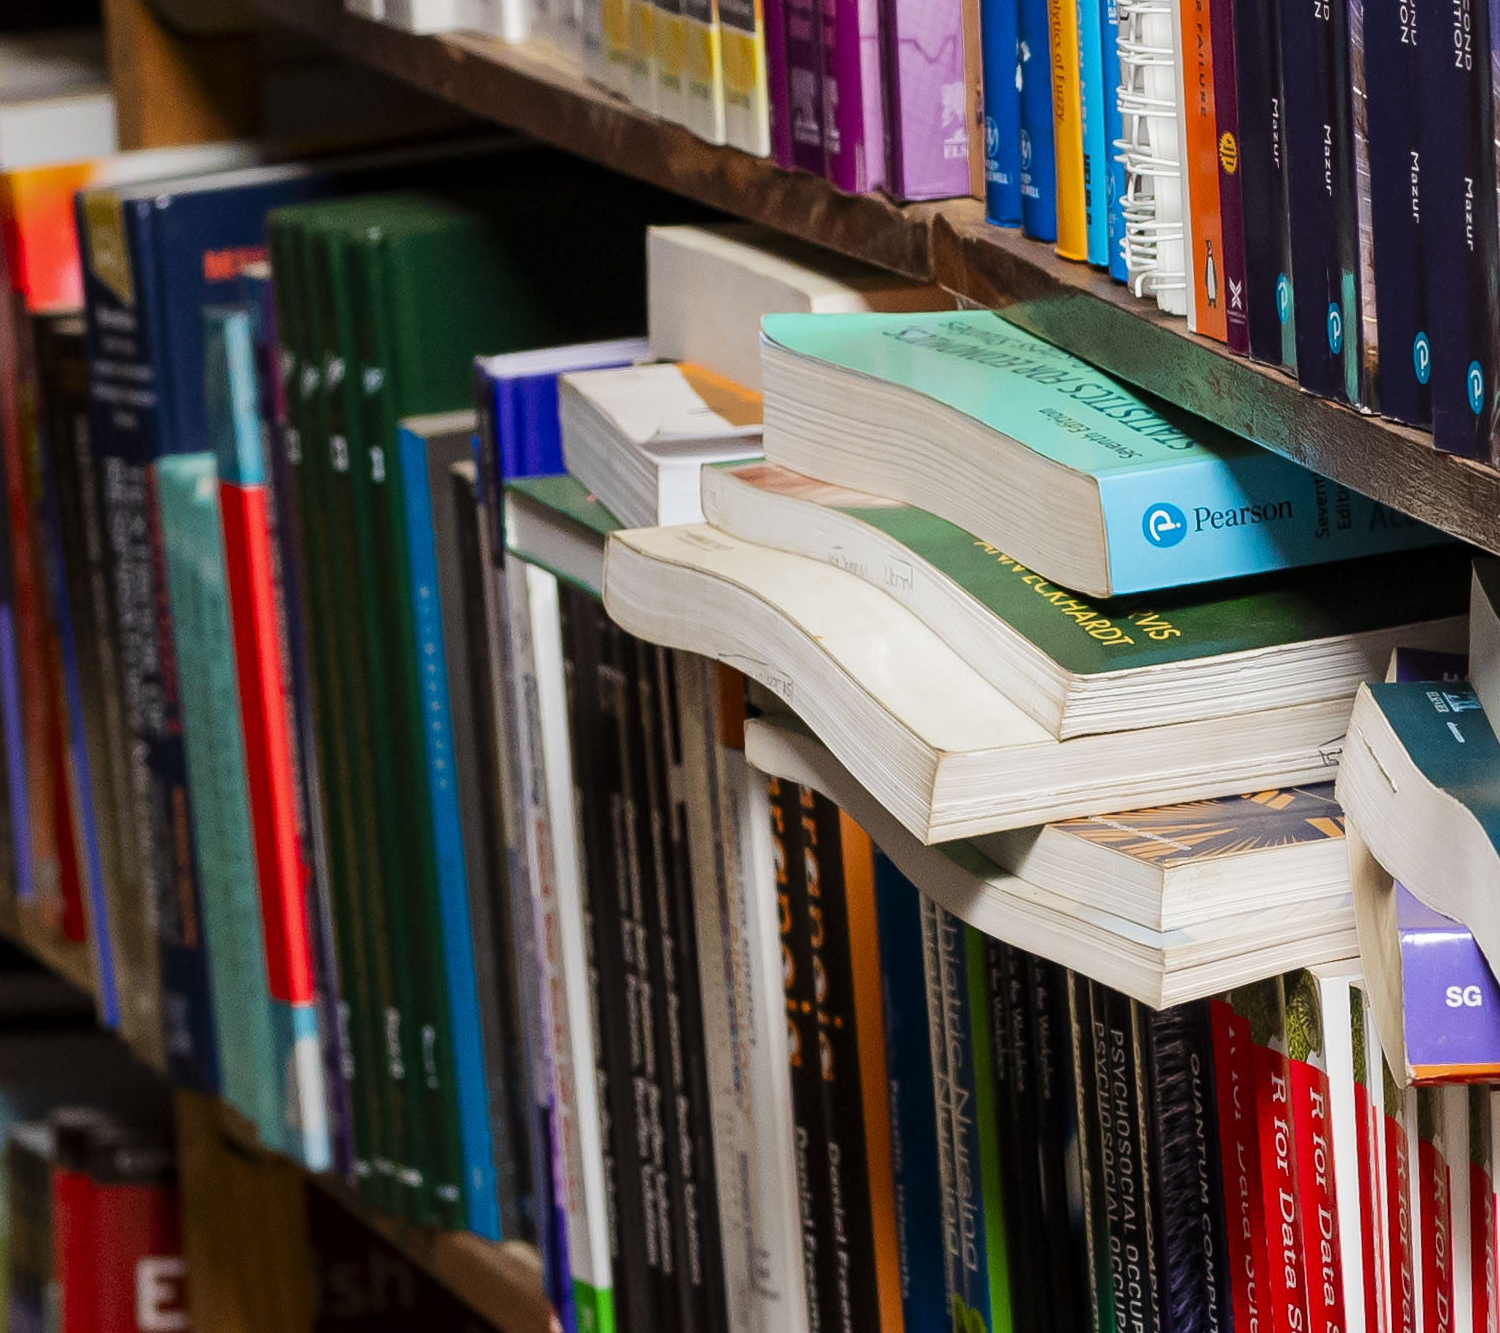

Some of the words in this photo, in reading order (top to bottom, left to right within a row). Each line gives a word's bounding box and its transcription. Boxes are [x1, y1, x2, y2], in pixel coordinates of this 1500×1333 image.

[1271, 98, 1280, 169] Mazur
[1323, 124, 1334, 196] Mazur
[1410, 151, 1421, 224] Mazur
[1463, 178, 1477, 252] Mazur
[1057, 382, 1195, 450] STATISTICS
[1082, 432, 1143, 459] Seventh
[1192, 497, 1294, 534] Pearson
[1445, 986, 1483, 1008] SG
[1270, 1072, 1286, 1103] R
[1309, 1086, 1326, 1120] R
[1109, 1028, 1135, 1234] PSYCHOSOCIAL
[1189, 1052, 1214, 1203] QUANTUM
[1274, 1115, 1293, 1175] for
[1313, 1130, 1331, 1191] for
[827, 1140, 845, 1243] Daniel
[949, 1086, 980, 1272] Nursing
[1278, 1185, 1299, 1288] Data
[1318, 1205, 1338, 1306] Data
